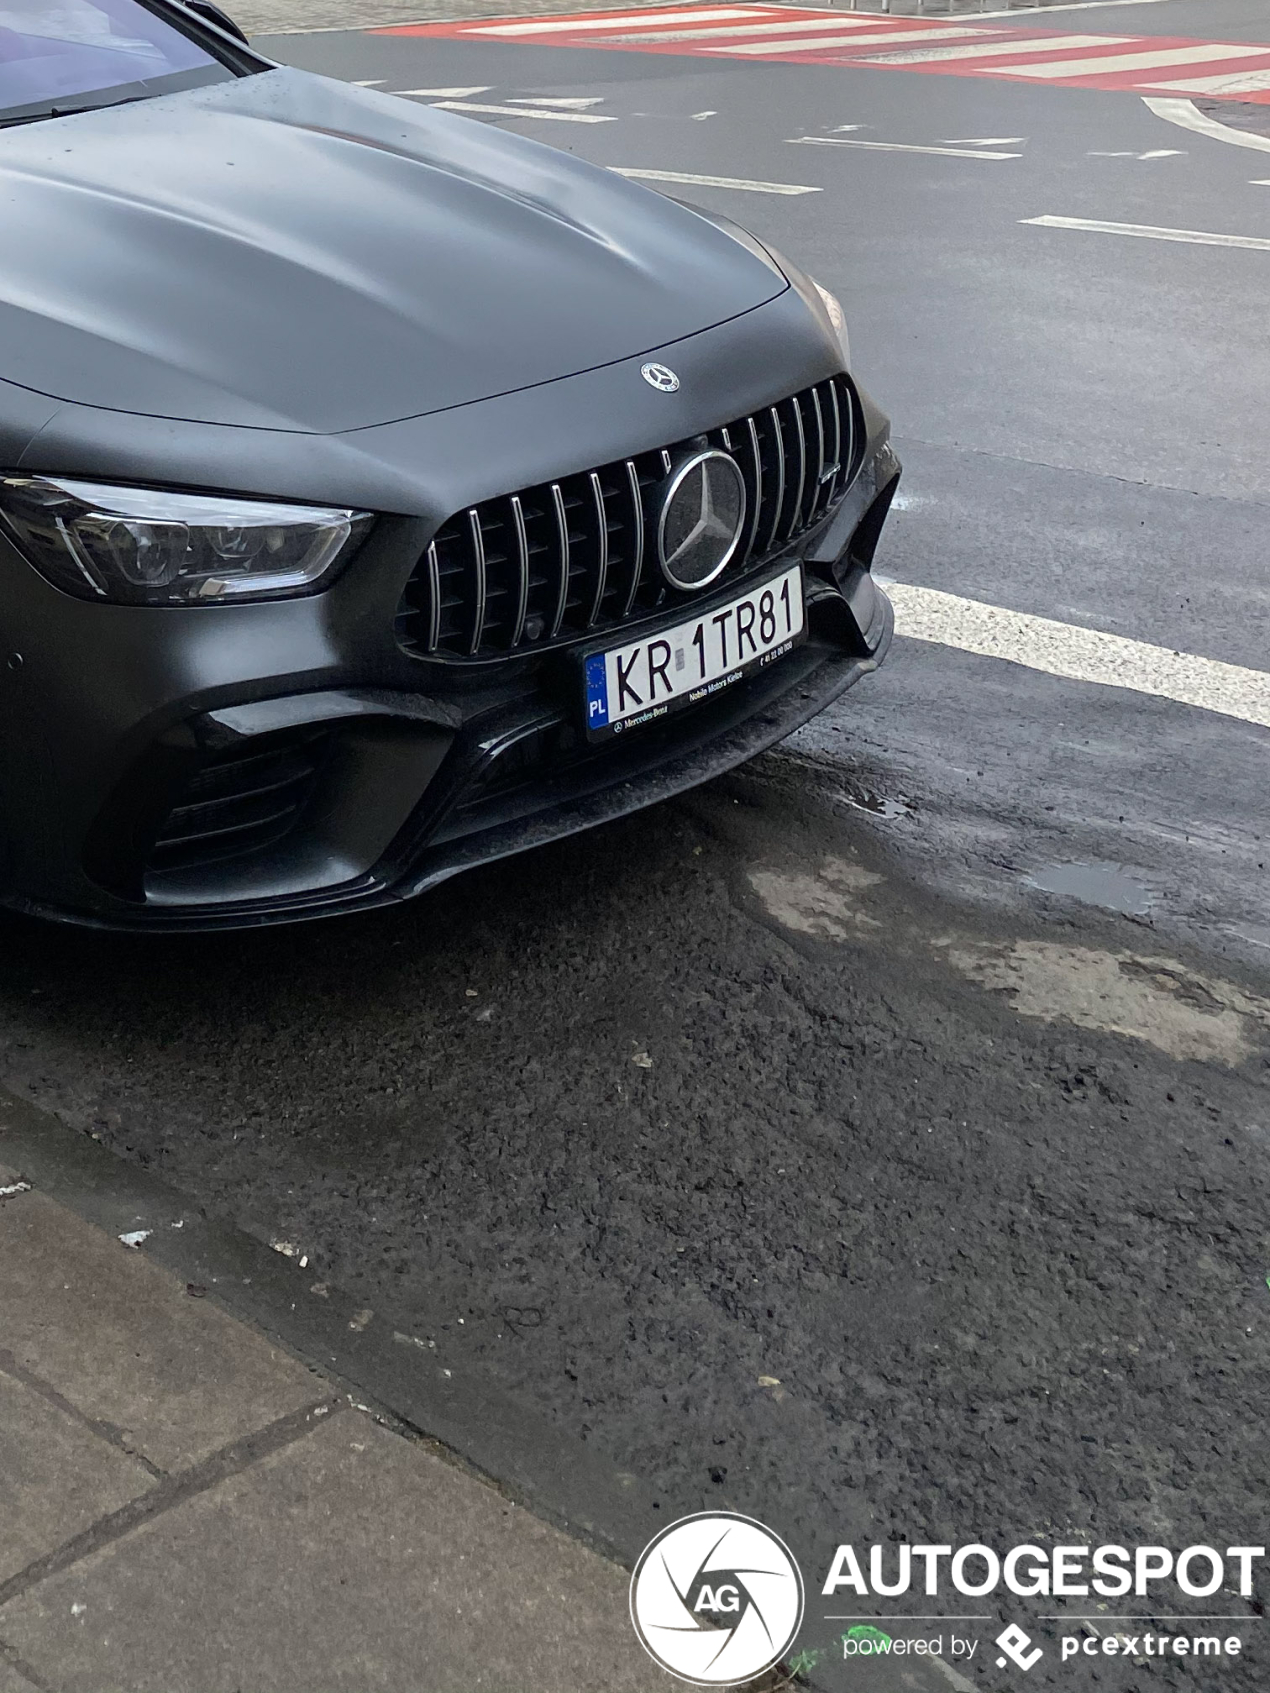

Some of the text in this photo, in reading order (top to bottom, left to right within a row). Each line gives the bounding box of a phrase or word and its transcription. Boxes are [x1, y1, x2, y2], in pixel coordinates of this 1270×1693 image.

[590, 578, 796, 717] PL KR 1TR81
[624, 706, 669, 729] Mercedes-Benz
[707, 678, 727, 694] Motors
